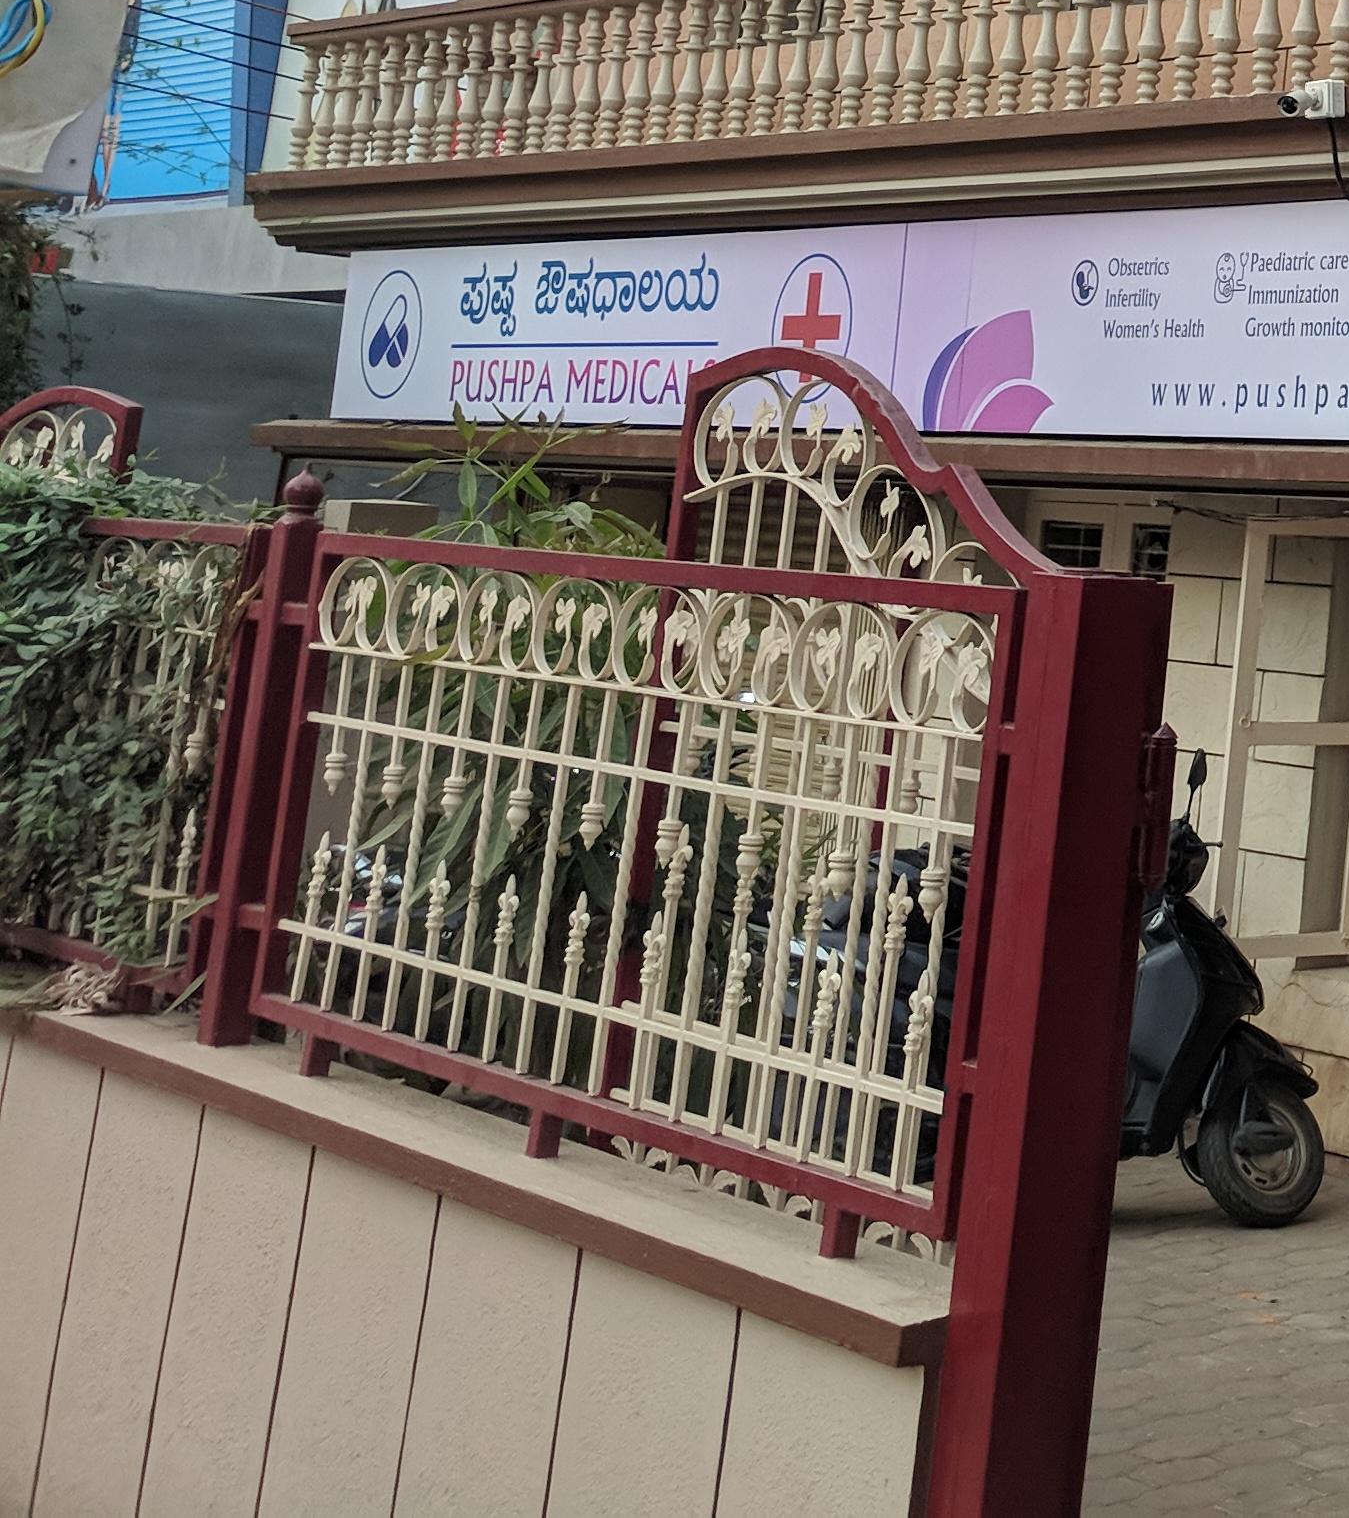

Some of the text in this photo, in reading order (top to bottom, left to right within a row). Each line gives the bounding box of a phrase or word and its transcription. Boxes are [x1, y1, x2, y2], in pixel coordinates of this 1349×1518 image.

[1108, 257, 1170, 277] Obstetrics
[1250, 251, 1349, 272] Paediatric care
[460, 252, 720, 337] ಪುಷ್ಪ ಔಷಧಾಲಯ
[1105, 288, 1161, 310] Infertility
[1248, 284, 1339, 305] Immunization
[1103, 318, 1205, 338] Women's Health
[1245, 317, 1295, 337] Growth
[450, 358, 718, 405] PUSHPA MEDICA
